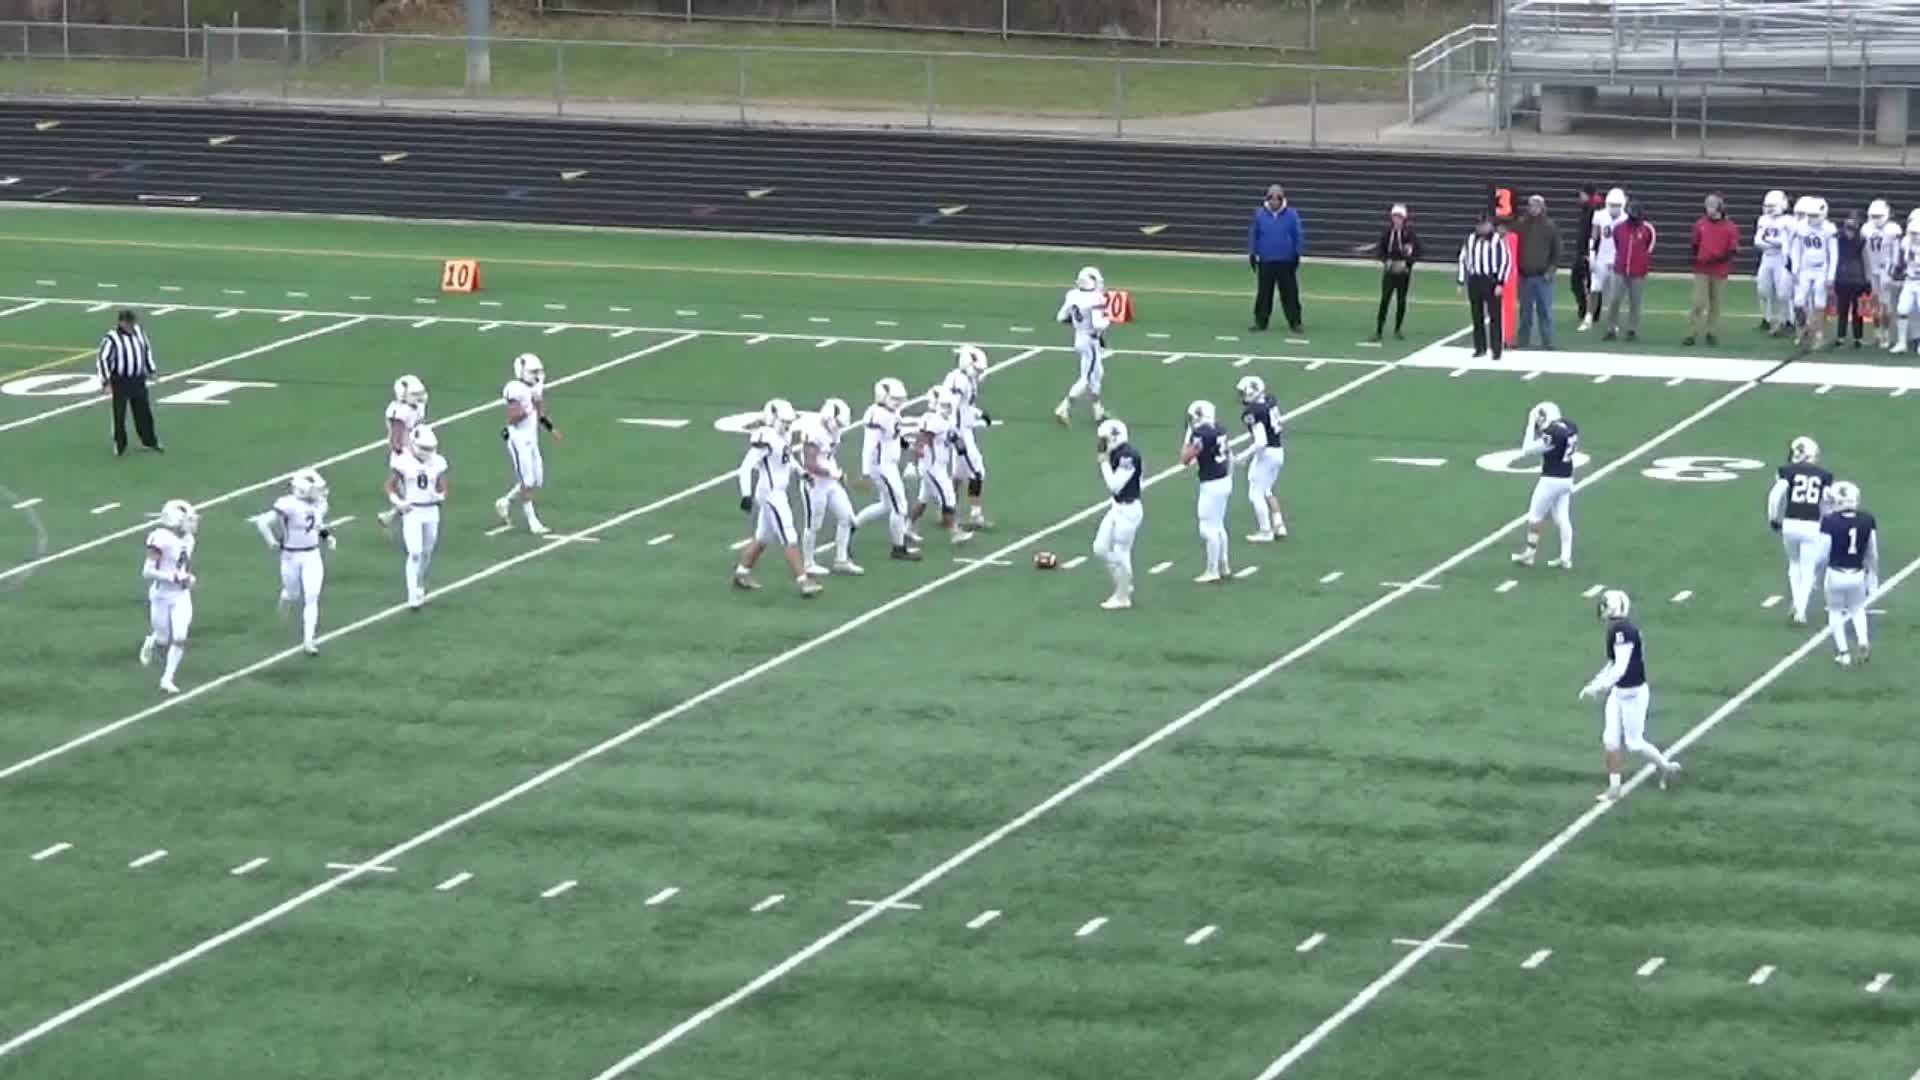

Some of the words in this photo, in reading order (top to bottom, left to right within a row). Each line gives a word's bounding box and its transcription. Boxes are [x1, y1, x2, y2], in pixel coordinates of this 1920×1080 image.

[1495, 188, 1512, 217] 3
[446, 264, 469, 288] 10
[1791, 474, 1821, 504] 26
[1848, 527, 1857, 555] 1
